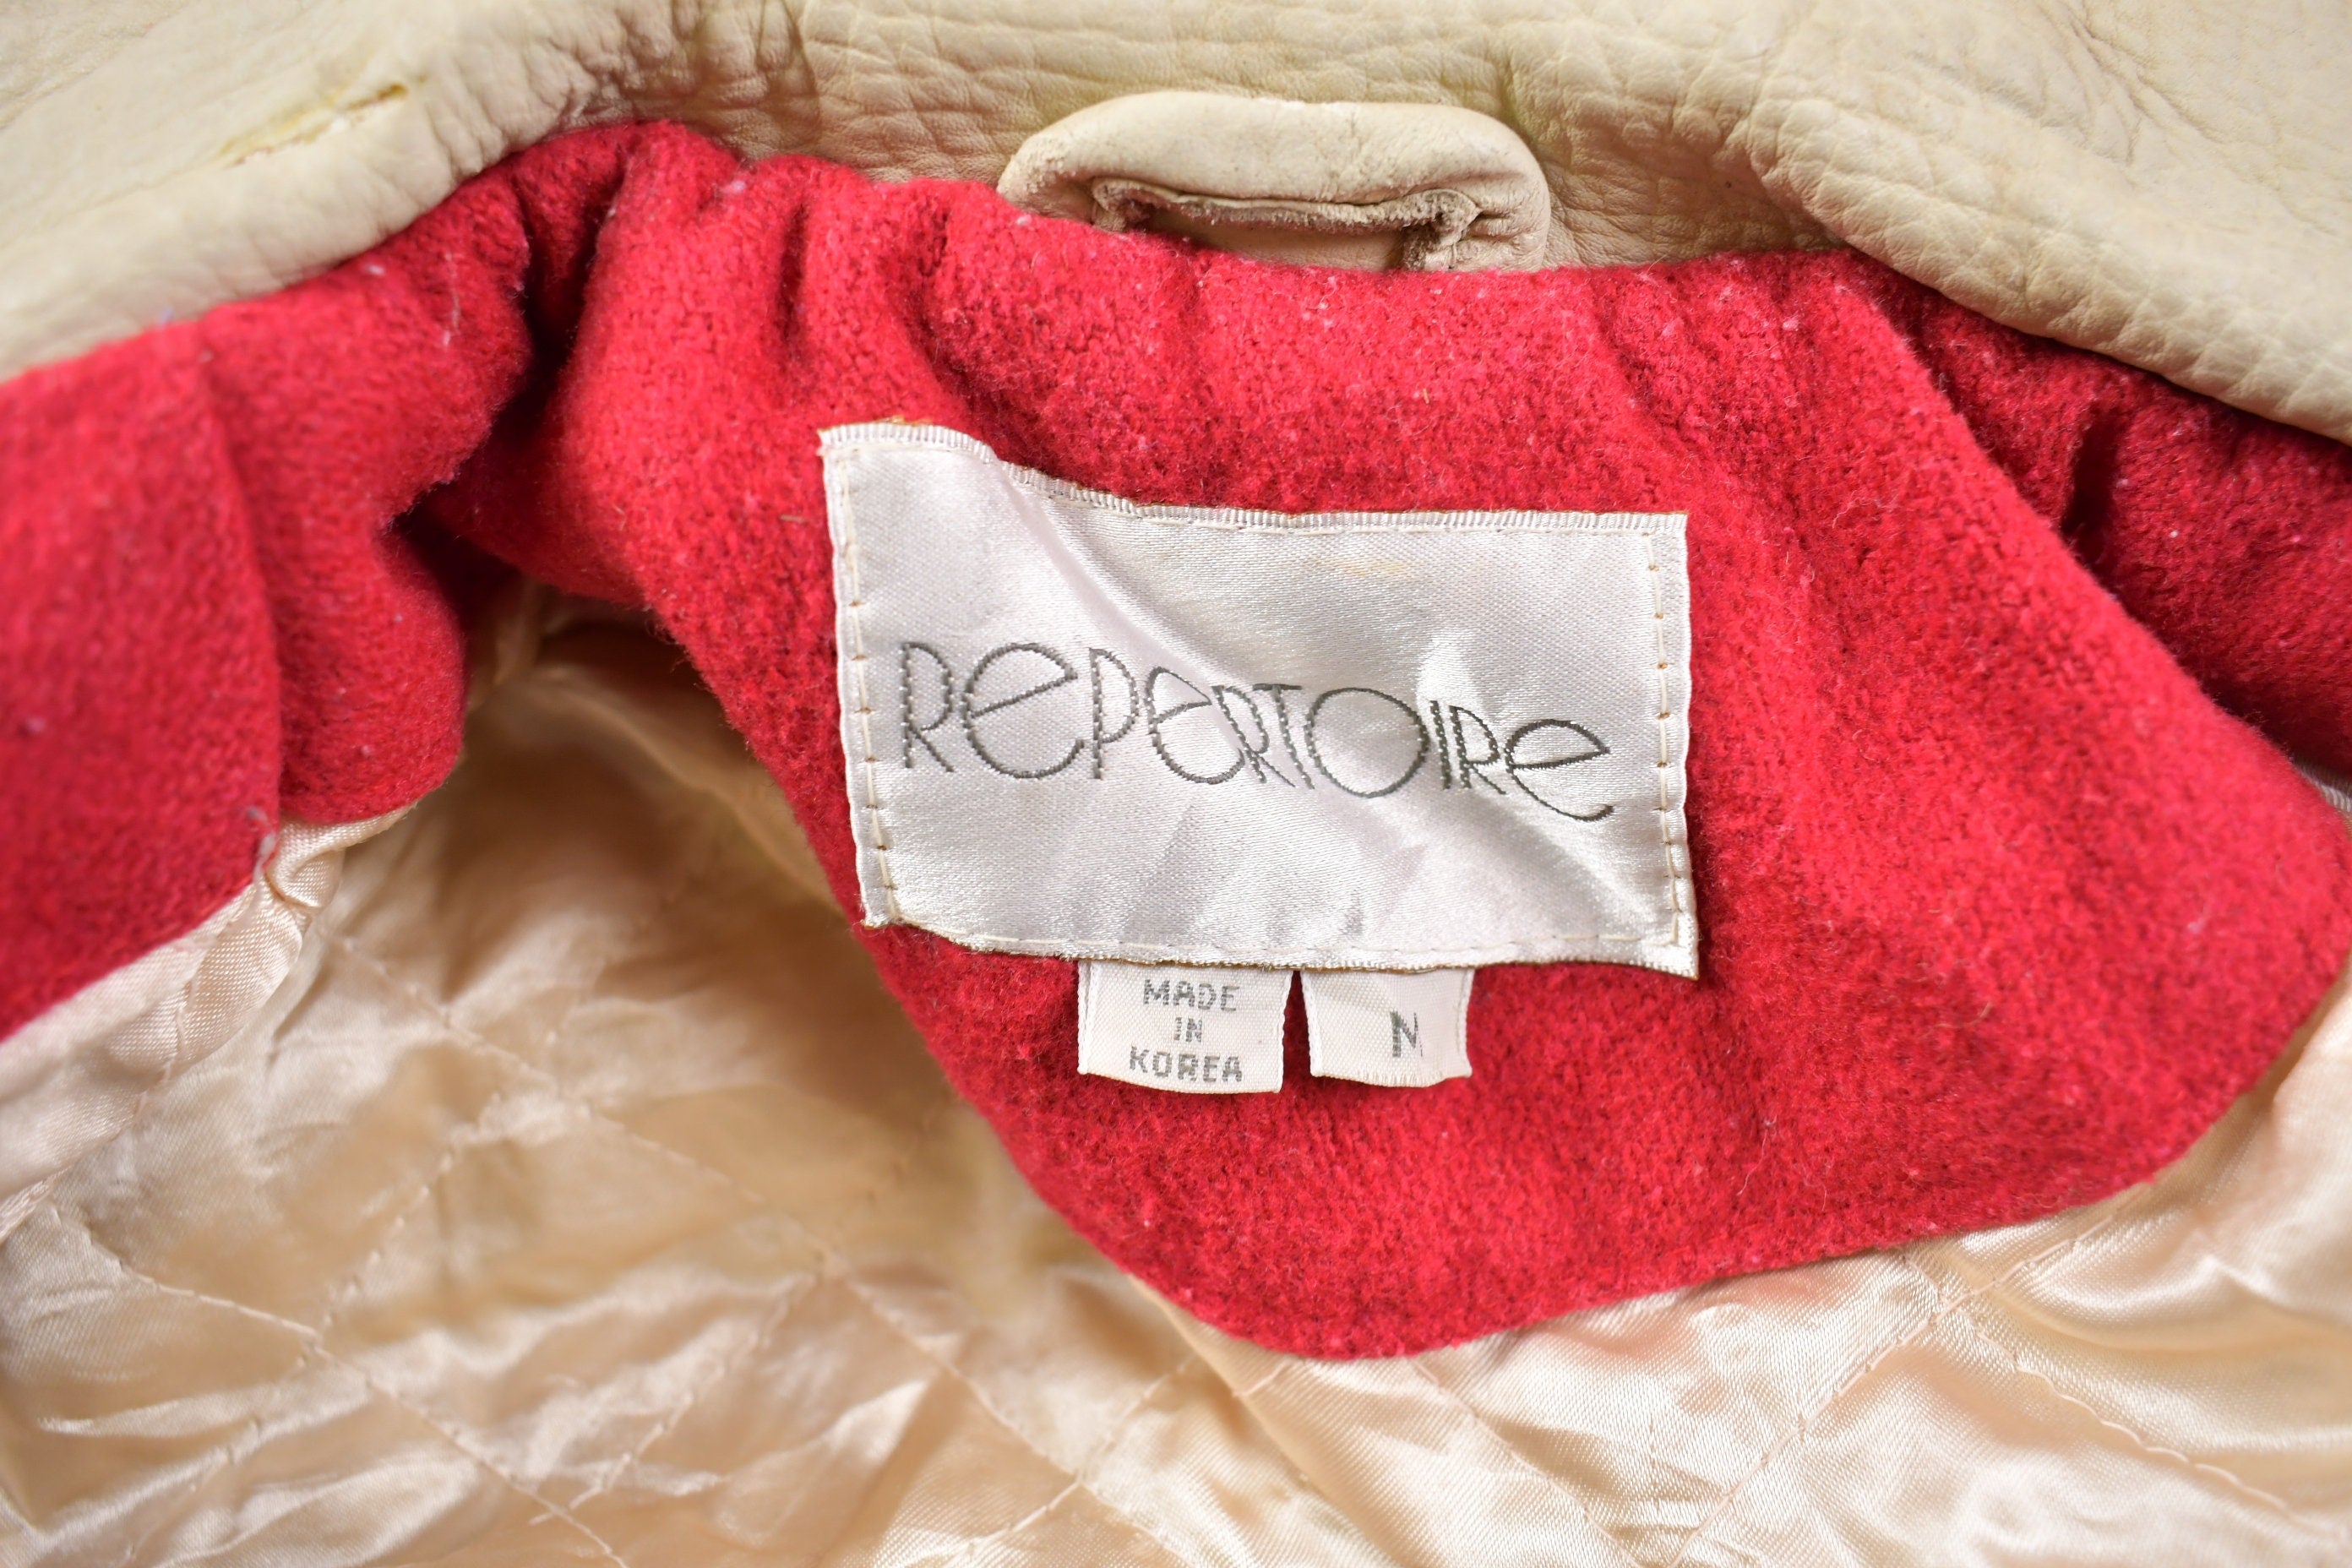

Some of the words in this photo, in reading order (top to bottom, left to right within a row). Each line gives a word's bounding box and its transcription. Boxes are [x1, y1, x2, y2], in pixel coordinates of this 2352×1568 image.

[1143, 978, 1240, 1012] MADE
[1173, 1017, 1203, 1043] IN
[1129, 1046, 1244, 1083] KOREA
